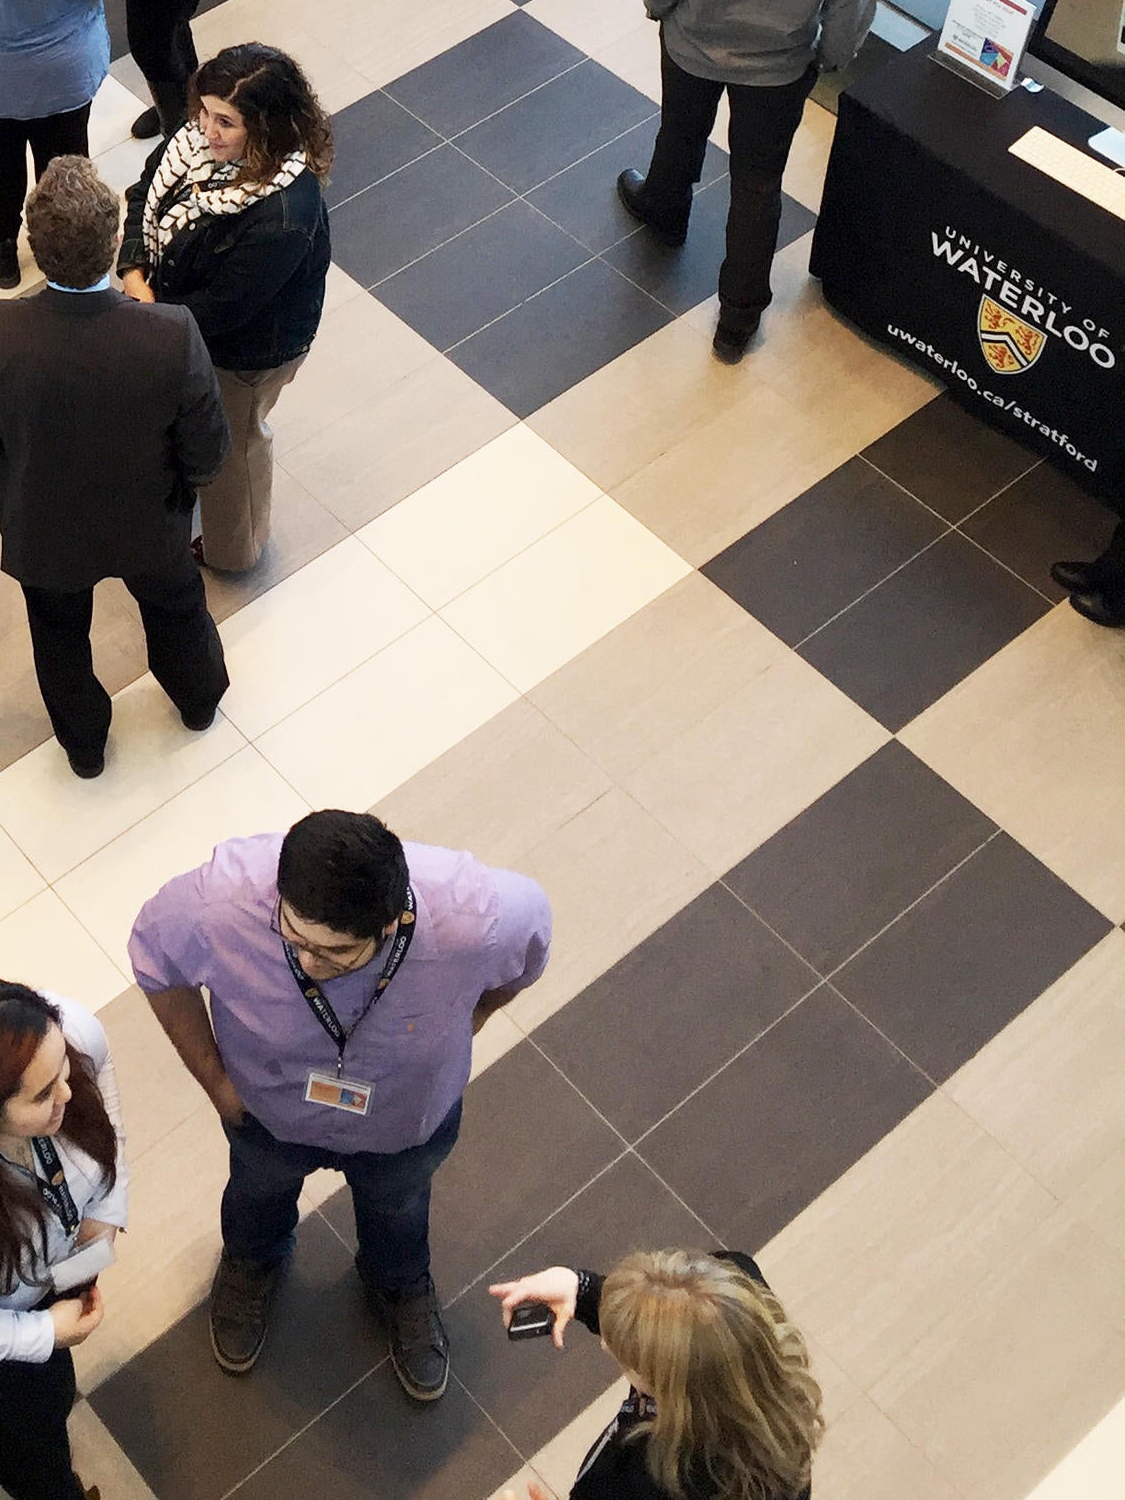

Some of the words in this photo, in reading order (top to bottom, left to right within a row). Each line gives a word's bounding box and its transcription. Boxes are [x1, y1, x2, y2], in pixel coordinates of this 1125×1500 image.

[931, 231, 1116, 369] WATERLOO
[945, 225, 1073, 315] UNIVERSITY
[1082, 318, 1111, 339] OF
[887, 323, 1099, 472] uwaterloo.ca/stratford
[312, 997, 341, 1038] WATERLOO
